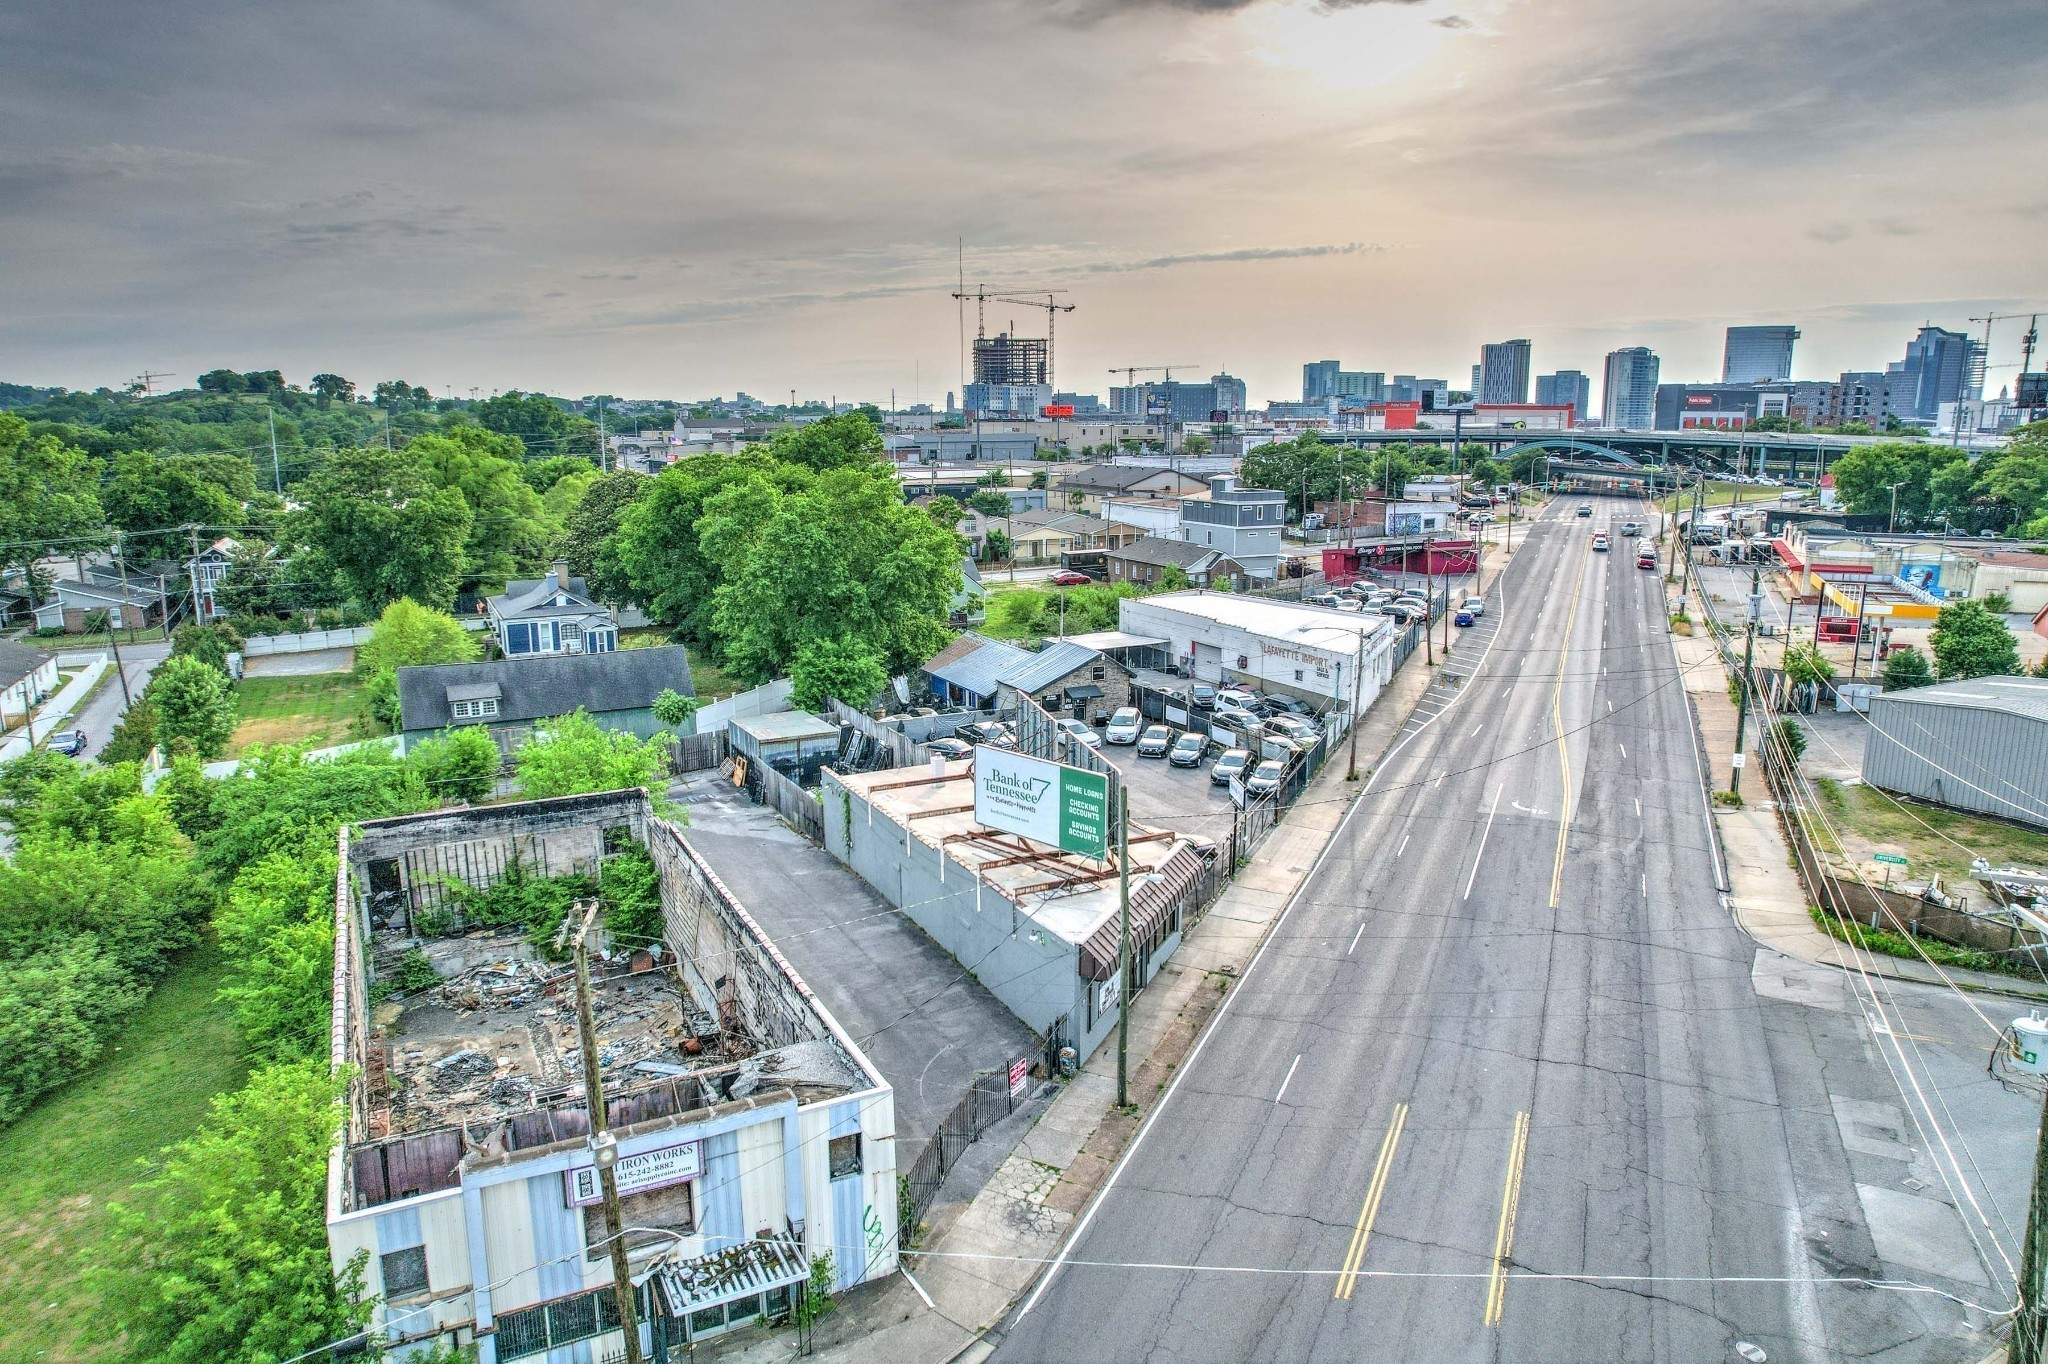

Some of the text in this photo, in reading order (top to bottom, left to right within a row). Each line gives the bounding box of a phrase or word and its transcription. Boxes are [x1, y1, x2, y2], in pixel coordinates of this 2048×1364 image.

[1264, 644, 1329, 668] LAFAYETTE IMPORT
[992, 768, 1034, 791] Bank of
[983, 777, 1038, 804] Tennessee
[1065, 783, 1104, 800] HOME LOANS
[1068, 806, 1100, 821] ACCOUNTS
[1070, 798, 1099, 813] CHECKING
[1068, 828, 1100, 843] ACCOUNTS
[1071, 821, 1097, 835] SAVINGS
[621, 1155, 650, 1171] IRON
[652, 1144, 693, 1163] WORKS
[618, 1161, 675, 1180] 615-242-8882
